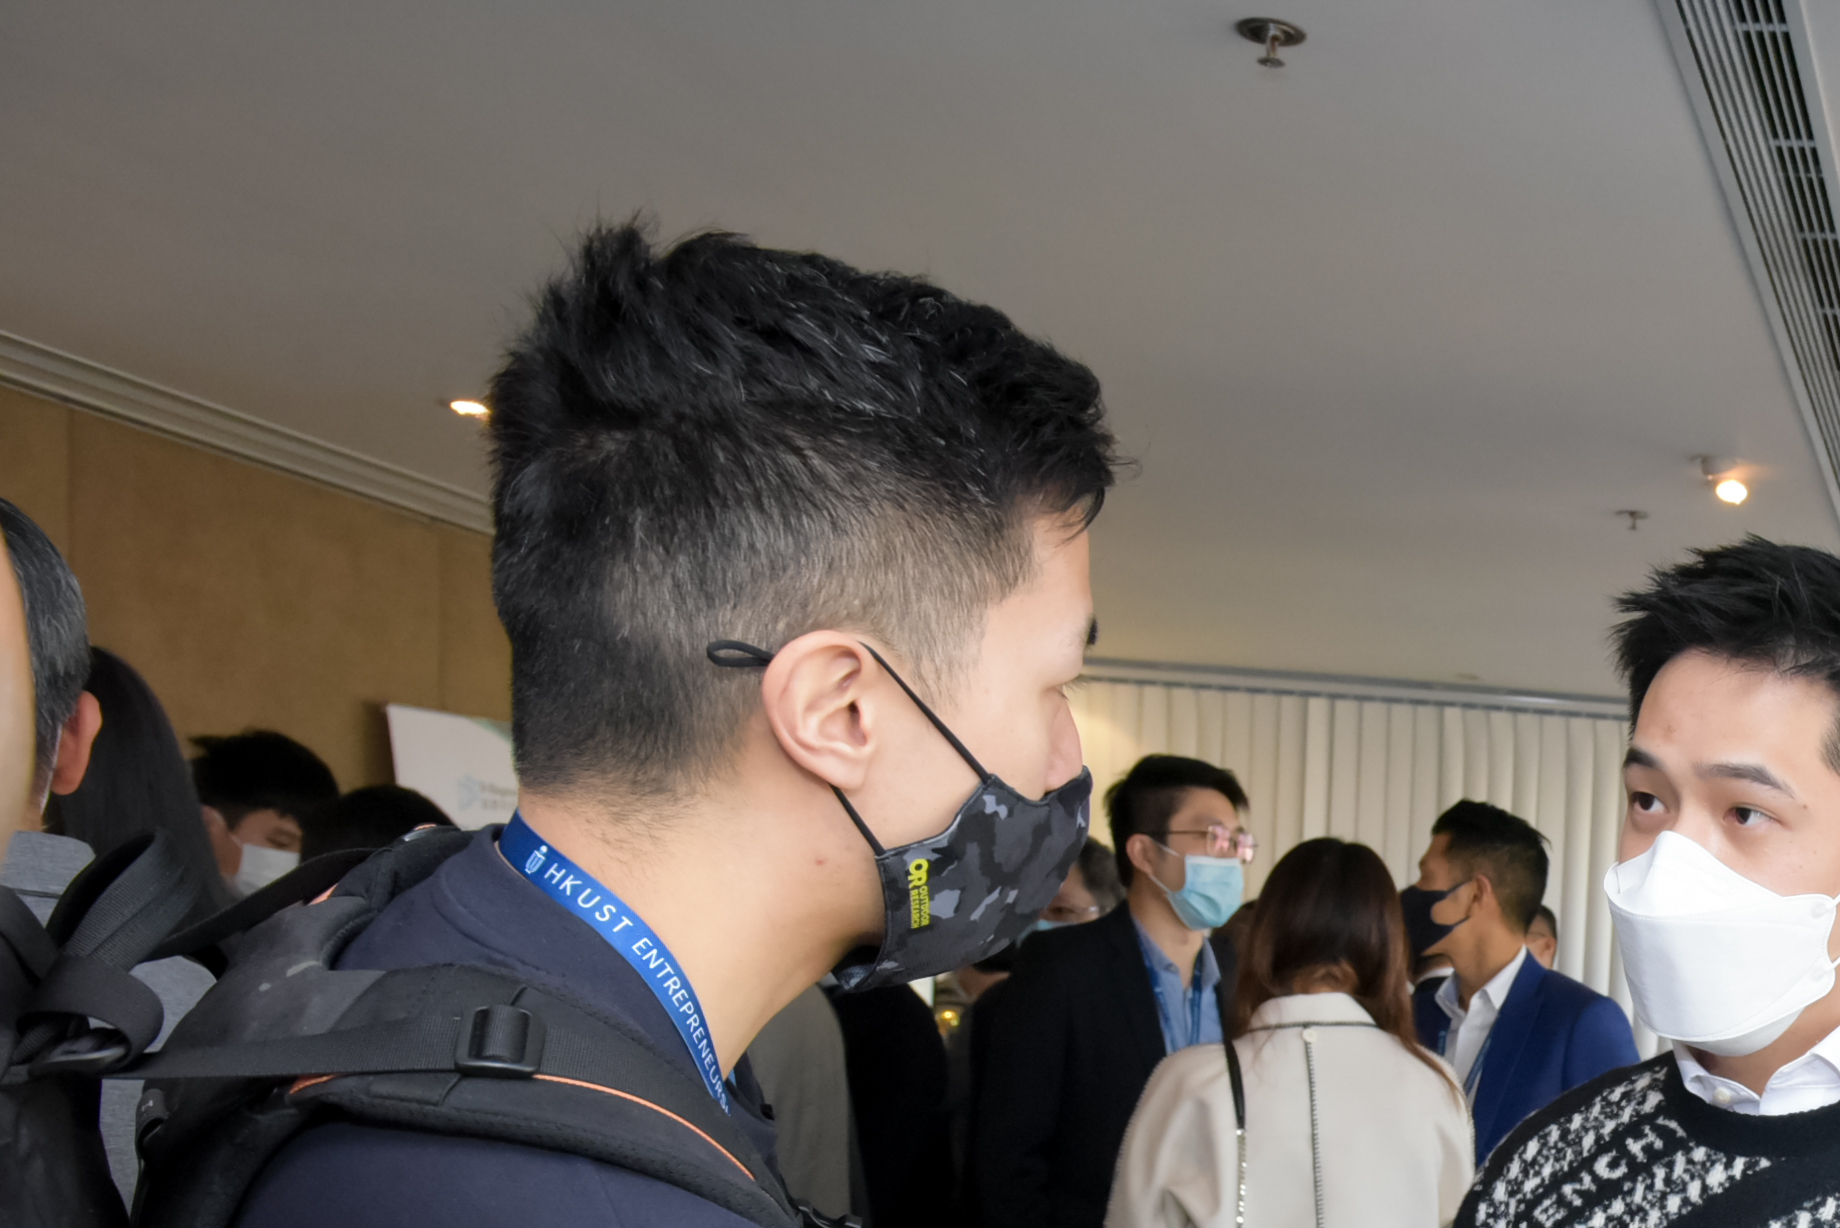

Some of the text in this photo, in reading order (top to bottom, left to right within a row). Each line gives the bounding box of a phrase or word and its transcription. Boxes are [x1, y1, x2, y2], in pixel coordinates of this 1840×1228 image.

[908, 858, 929, 889] OR
[544, 862, 633, 933] HKUST
[910, 889, 920, 929] RESEARCH
[919, 886, 930, 926] OUTDOOR
